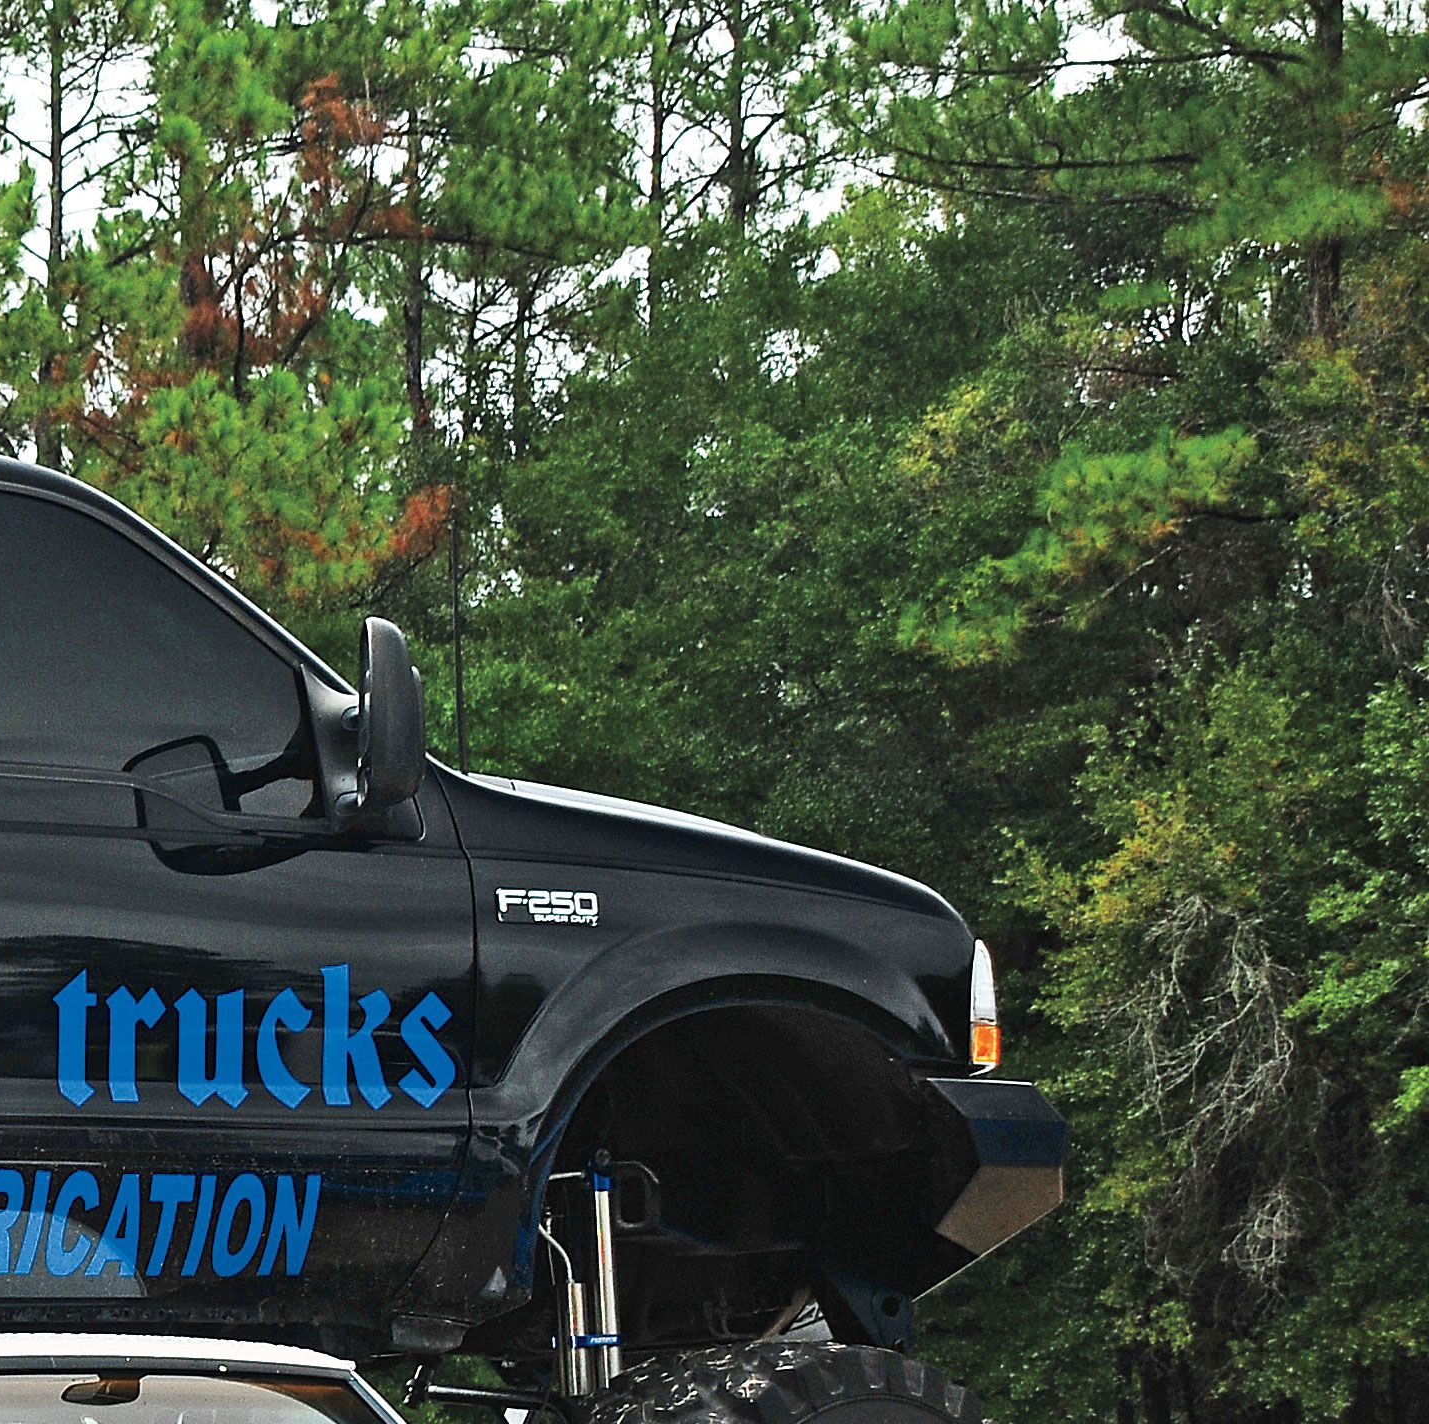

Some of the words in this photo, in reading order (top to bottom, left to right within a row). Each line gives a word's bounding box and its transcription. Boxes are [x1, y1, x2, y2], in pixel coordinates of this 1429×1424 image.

[495, 887, 599, 916] F-250
[533, 914, 569, 923] SUPER
[569, 914, 599, 927] DUTY
[52, 962, 456, 1112] trucks
